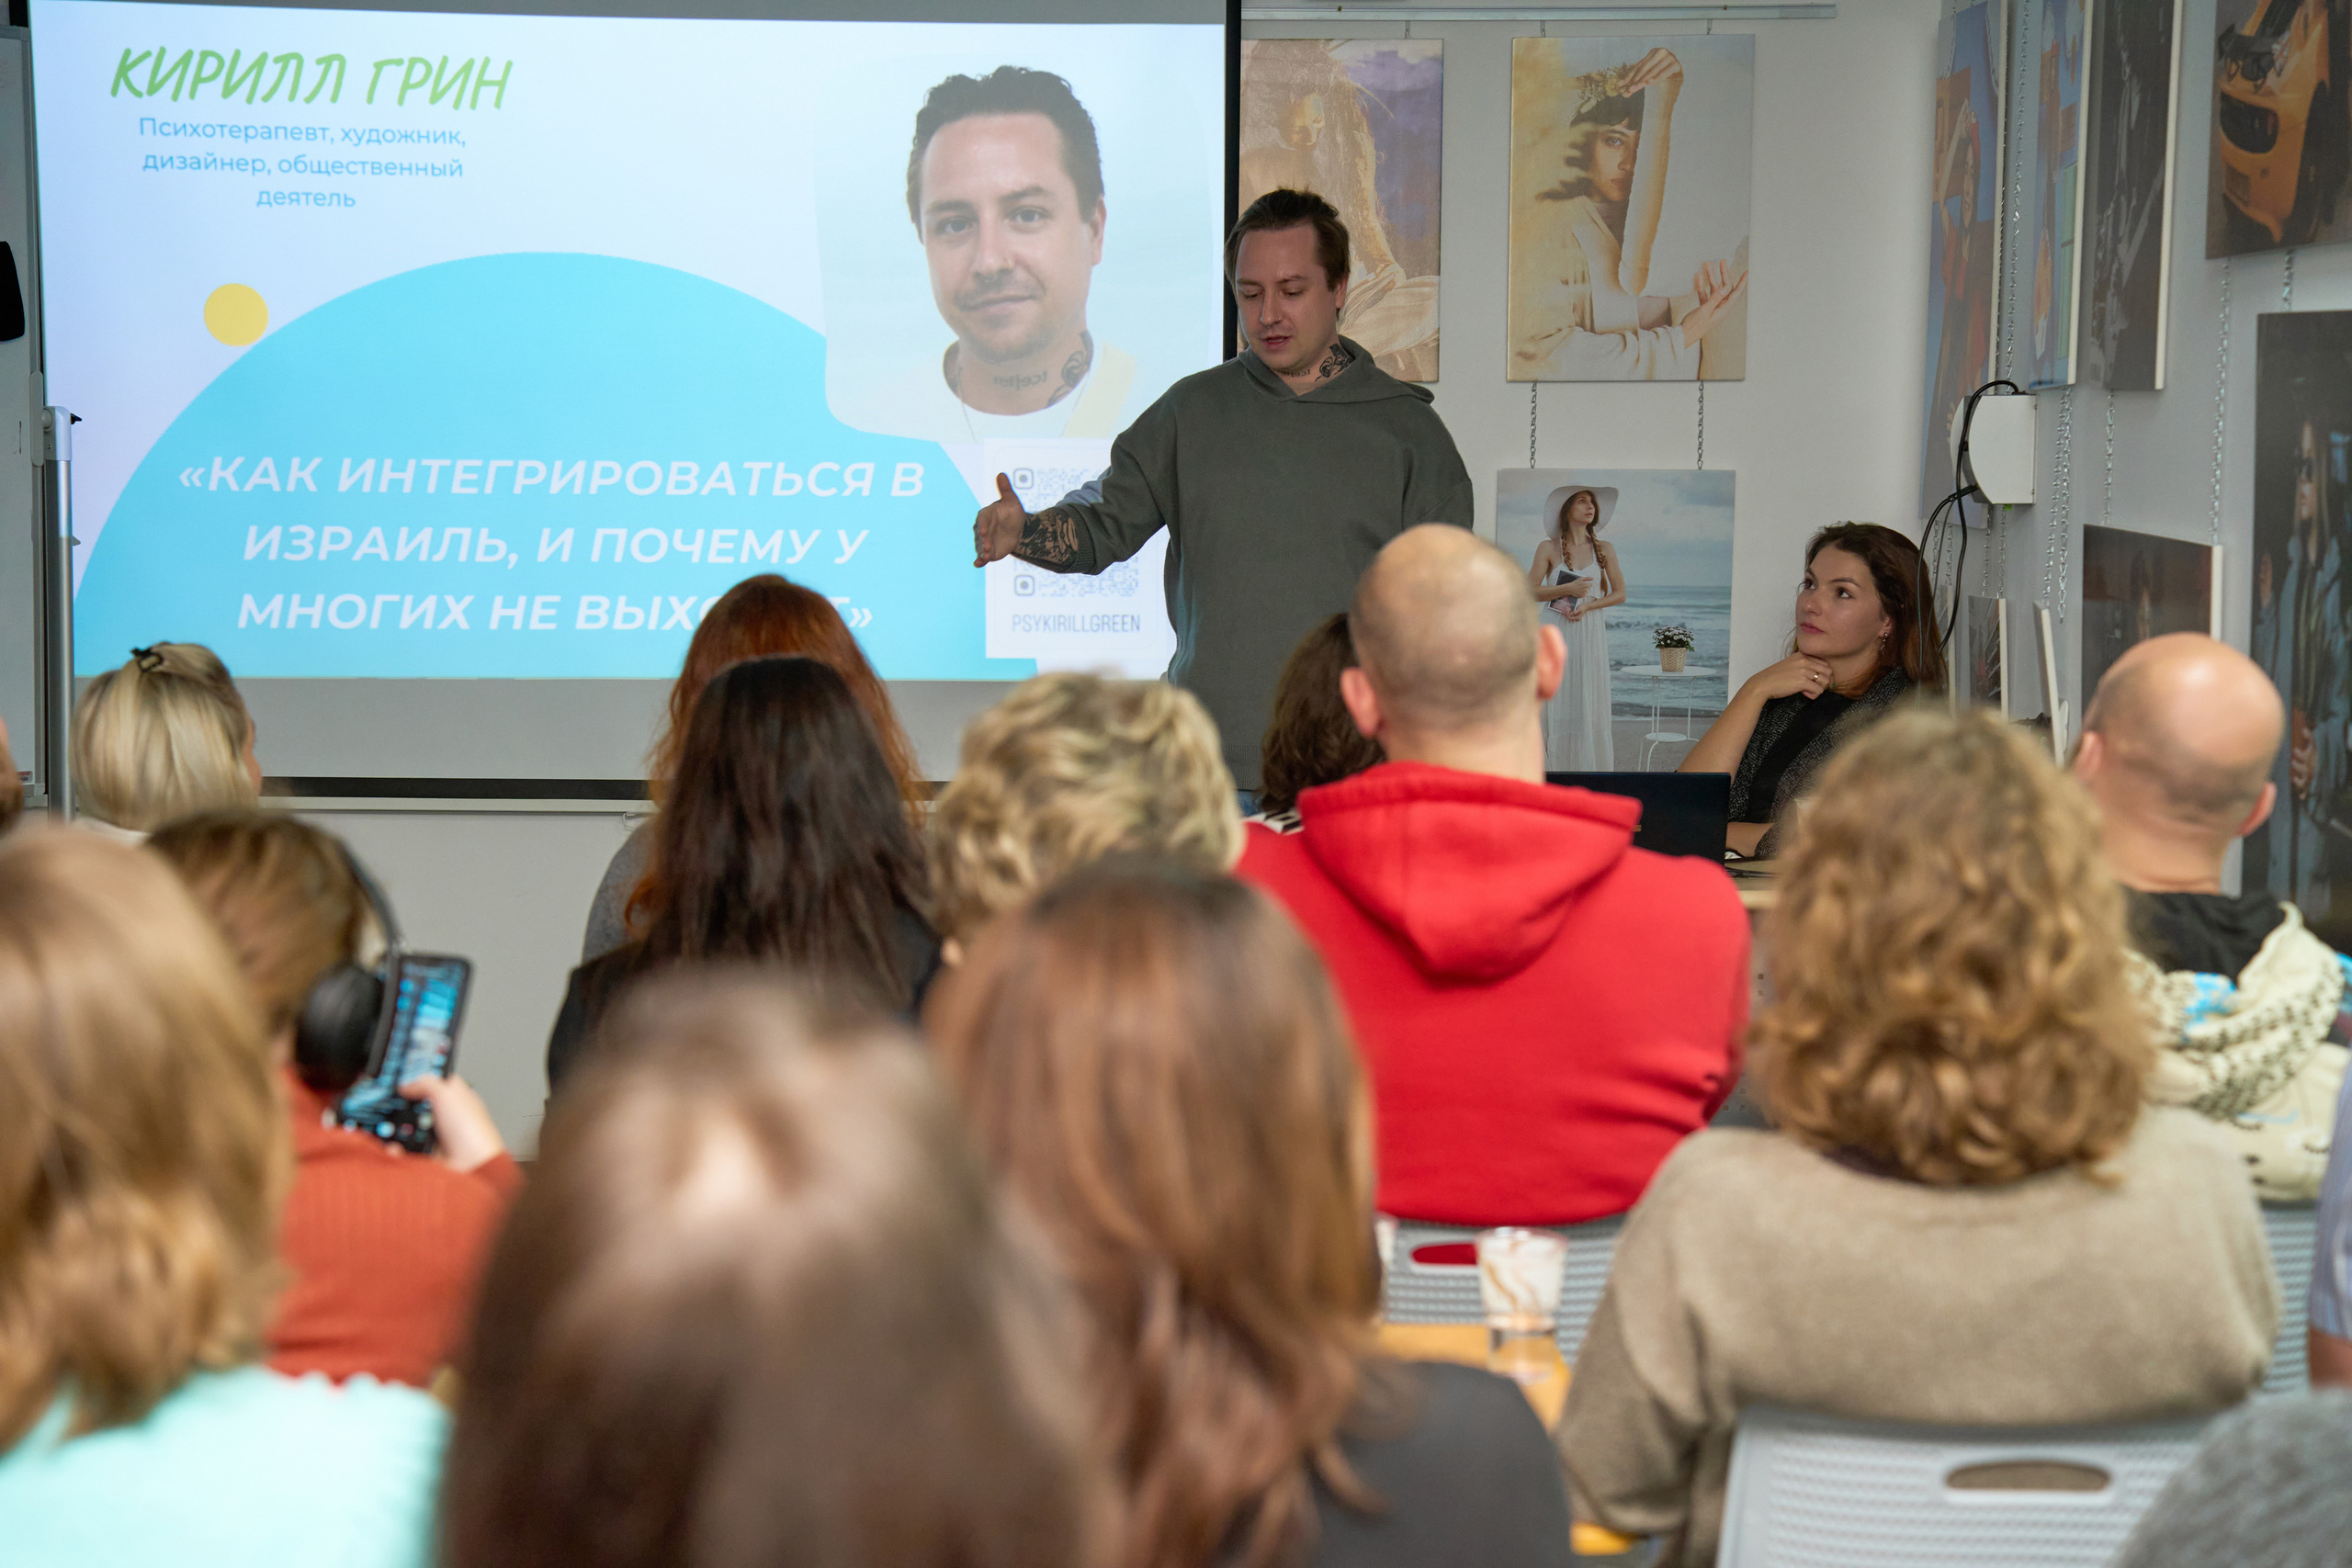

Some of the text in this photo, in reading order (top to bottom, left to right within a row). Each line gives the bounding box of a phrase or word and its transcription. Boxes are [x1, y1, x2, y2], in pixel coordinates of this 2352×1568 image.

[110, 46, 514, 110] КИРИЛЛ ГРИН
[140, 117, 467, 149] Психотерапевт, художник,
[142, 153, 463, 177] дизайнер, общественный
[256, 189, 356, 208] деятель
[179, 457, 924, 497] «КАК ИНТЕГРИРОВАТЬСЯ В
[244, 525, 869, 570] ИЗРАИЛЬ, И ПОЧЕМУ У
[239, 593, 474, 629] МНОГИХ
[490, 595, 560, 630] НЕ
[1012, 614, 1141, 633] PSYKIRILLGREEN
